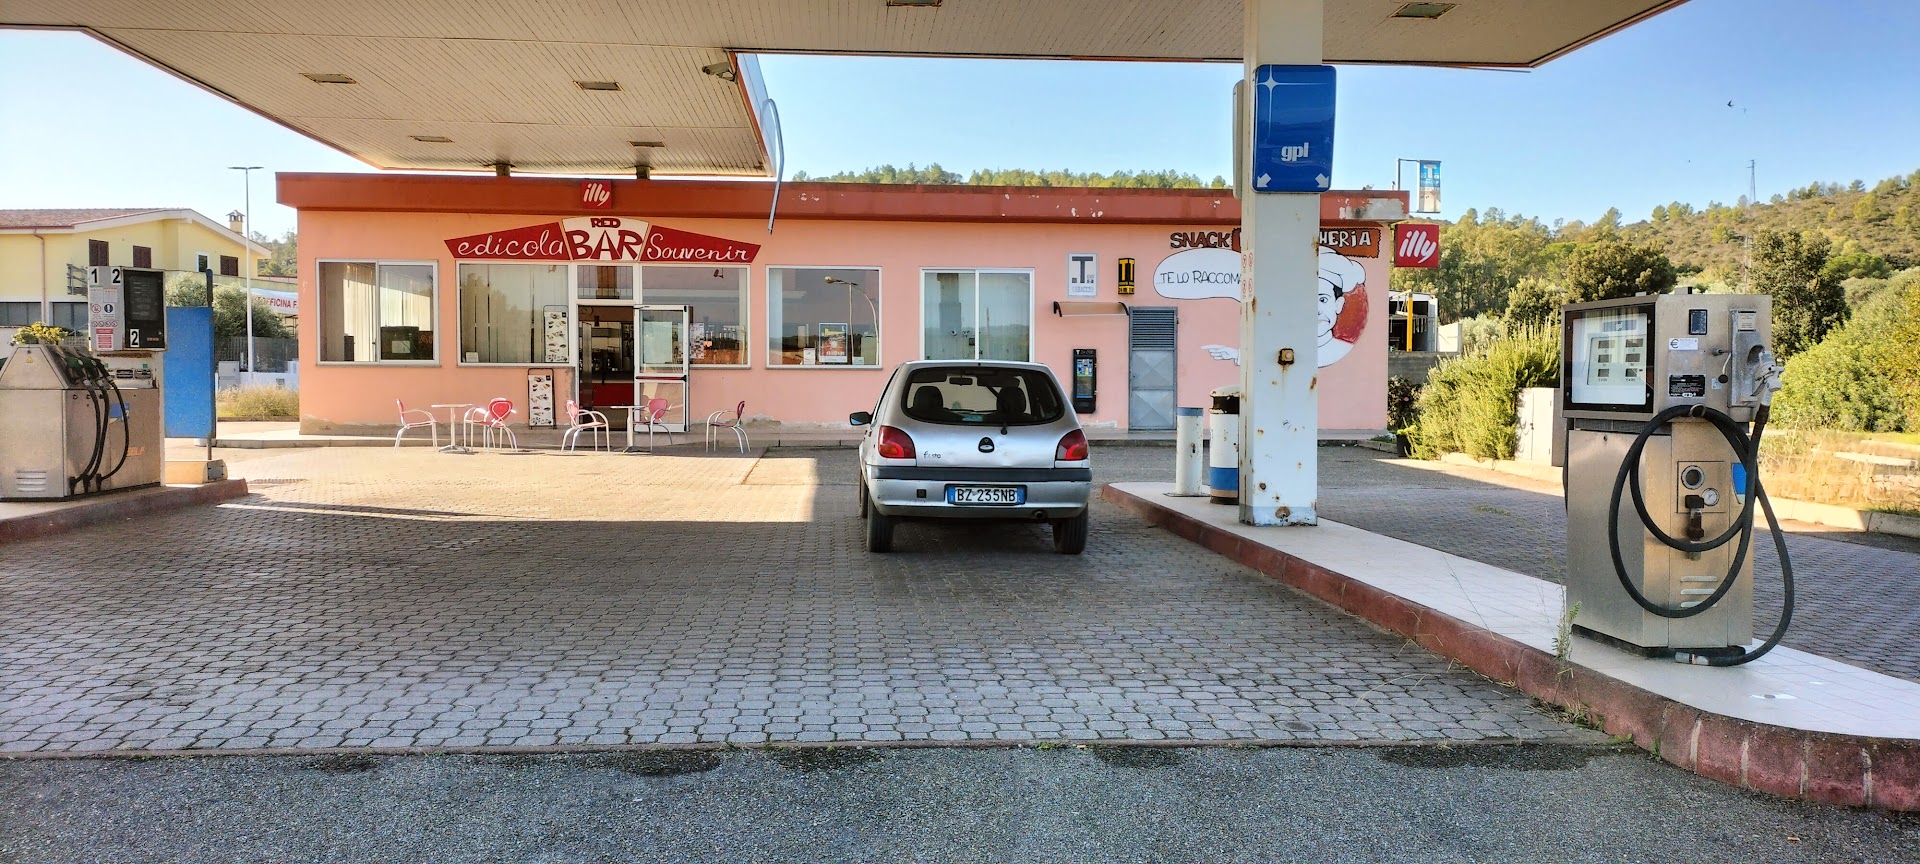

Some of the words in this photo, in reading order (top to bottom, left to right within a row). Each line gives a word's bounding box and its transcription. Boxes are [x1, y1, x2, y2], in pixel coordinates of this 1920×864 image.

[1281, 142, 1309, 162] gpl
[583, 182, 611, 207] illy
[591, 217, 621, 228] RED
[457, 229, 564, 256] edicola
[565, 229, 643, 260] BAR
[647, 233, 750, 260] Souvenir
[1170, 231, 1231, 249] SNACK
[1399, 229, 1437, 264] illy
[91, 268, 98, 284] 1
[112, 268, 121, 284] 2
[1176, 271, 1190, 284] LO
[131, 330, 139, 346] 2
[957, 488, 973, 502] BZ
[977, 488, 1016, 502] 235NB
